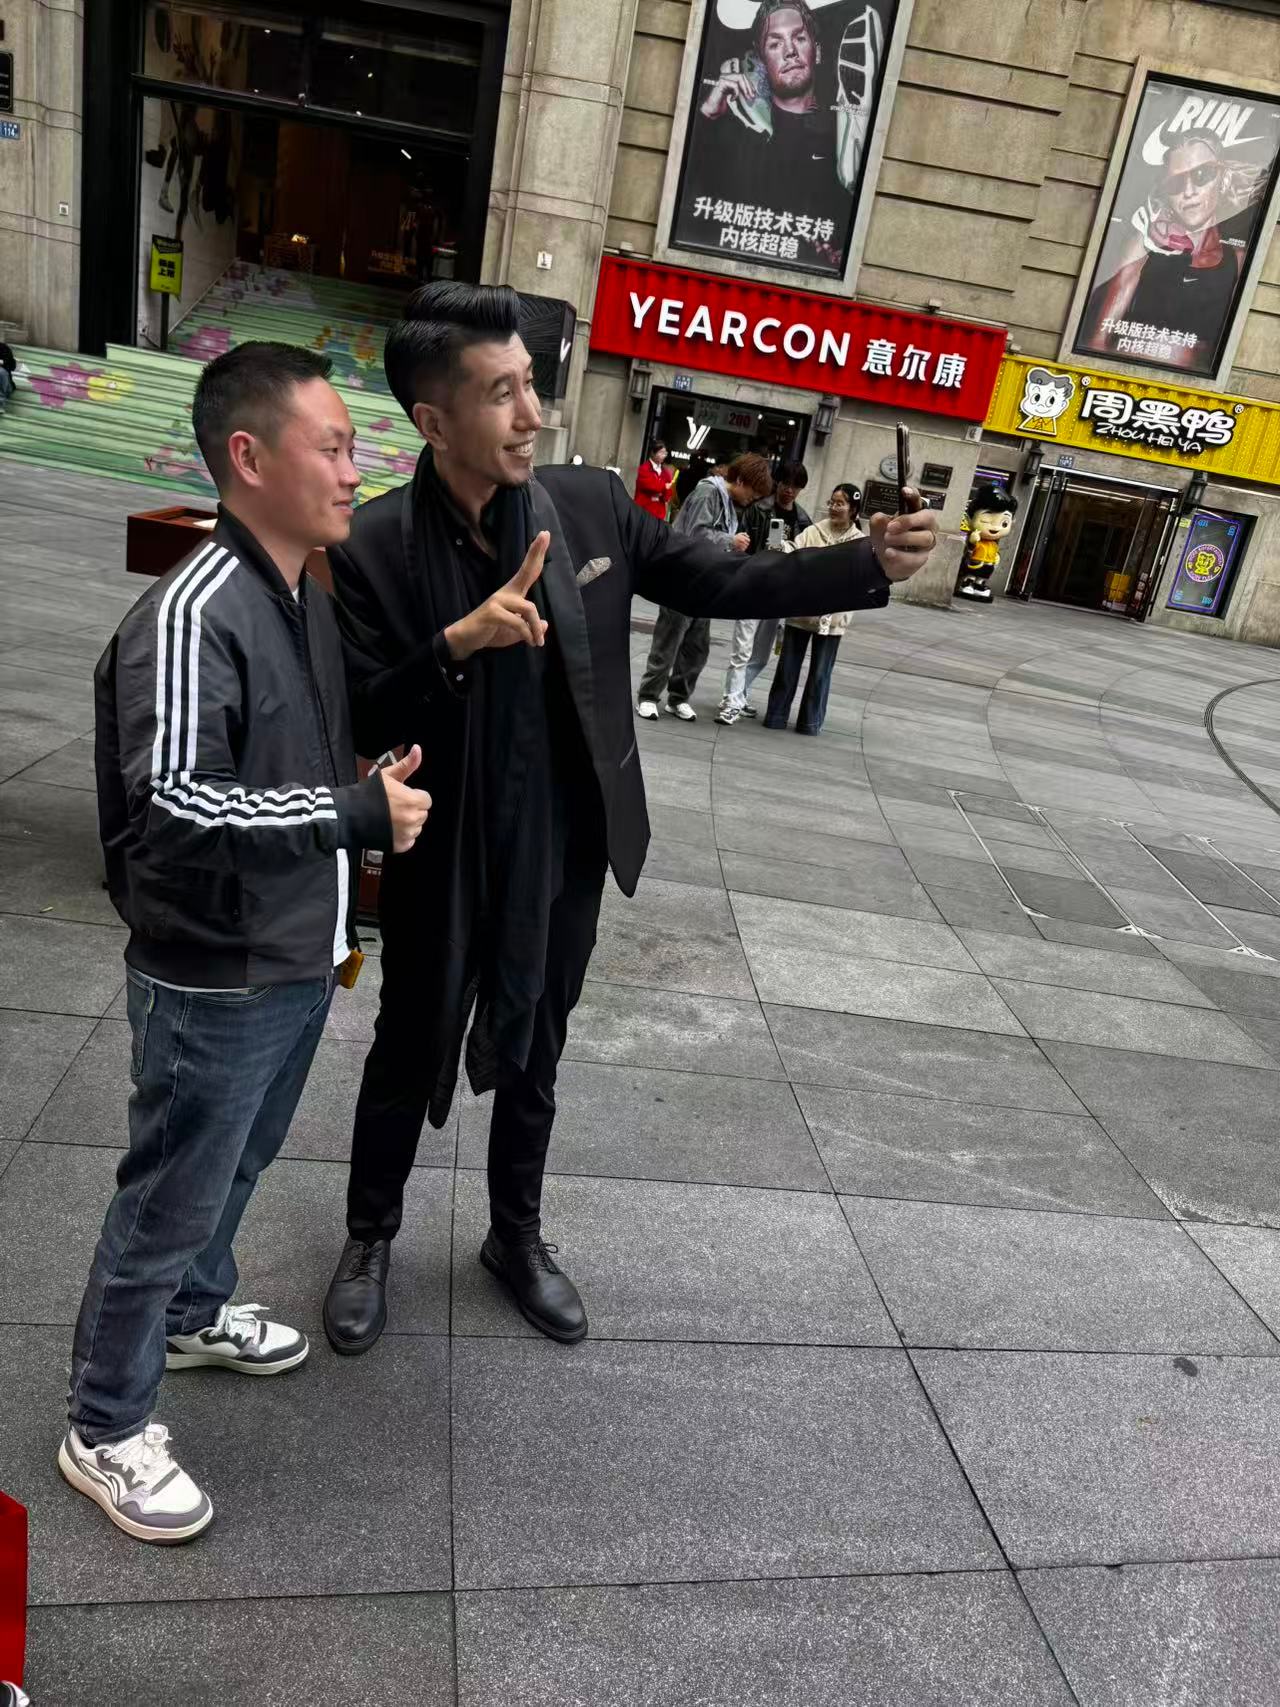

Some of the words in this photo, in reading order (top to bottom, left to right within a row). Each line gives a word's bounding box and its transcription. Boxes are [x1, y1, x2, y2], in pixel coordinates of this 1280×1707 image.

[1167, 96, 1255, 143] RUN
[693, 196, 835, 242] 升级版技术支持
[719, 226, 800, 259] 内核超稳
[629, 291, 851, 367] YEARCON
[861, 338, 968, 389] 意尔康
[1100, 318, 1198, 348] 升级版技术支持
[1081, 389, 1235, 445] 周黑鸭
[1096, 422, 1144, 440] ZHOU
[1147, 432, 1174, 447] HEI
[1178, 438, 1202, 453] YA
